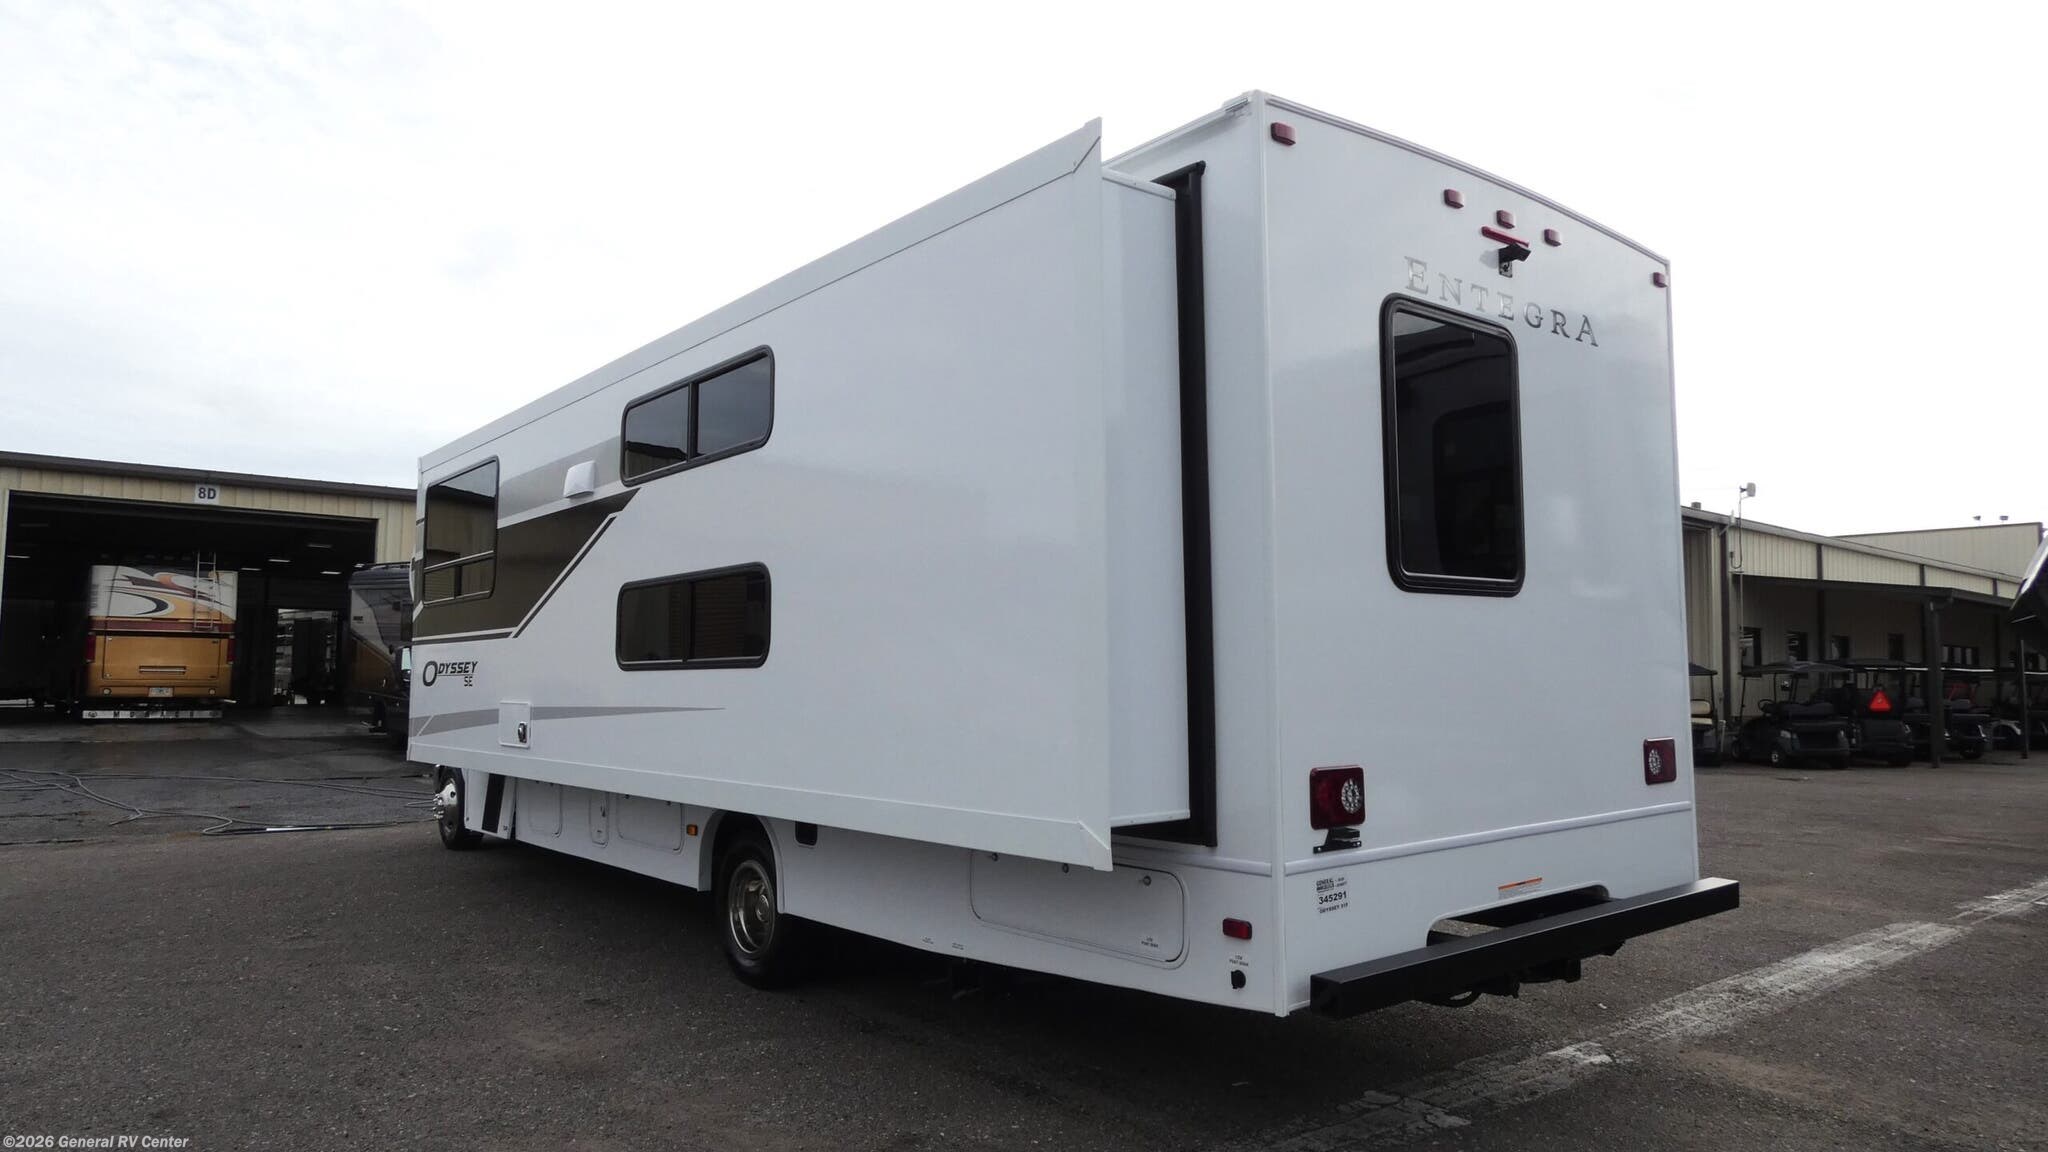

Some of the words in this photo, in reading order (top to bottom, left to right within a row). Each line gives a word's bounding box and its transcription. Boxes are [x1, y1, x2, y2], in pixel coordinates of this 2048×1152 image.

[1404, 255, 1599, 347] ENTEGRA
[198, 487, 217, 500] 8D
[422, 660, 478, 687] ODYSSEY
[463, 676, 473, 687] SE
[1318, 890, 1347, 905] 345291
